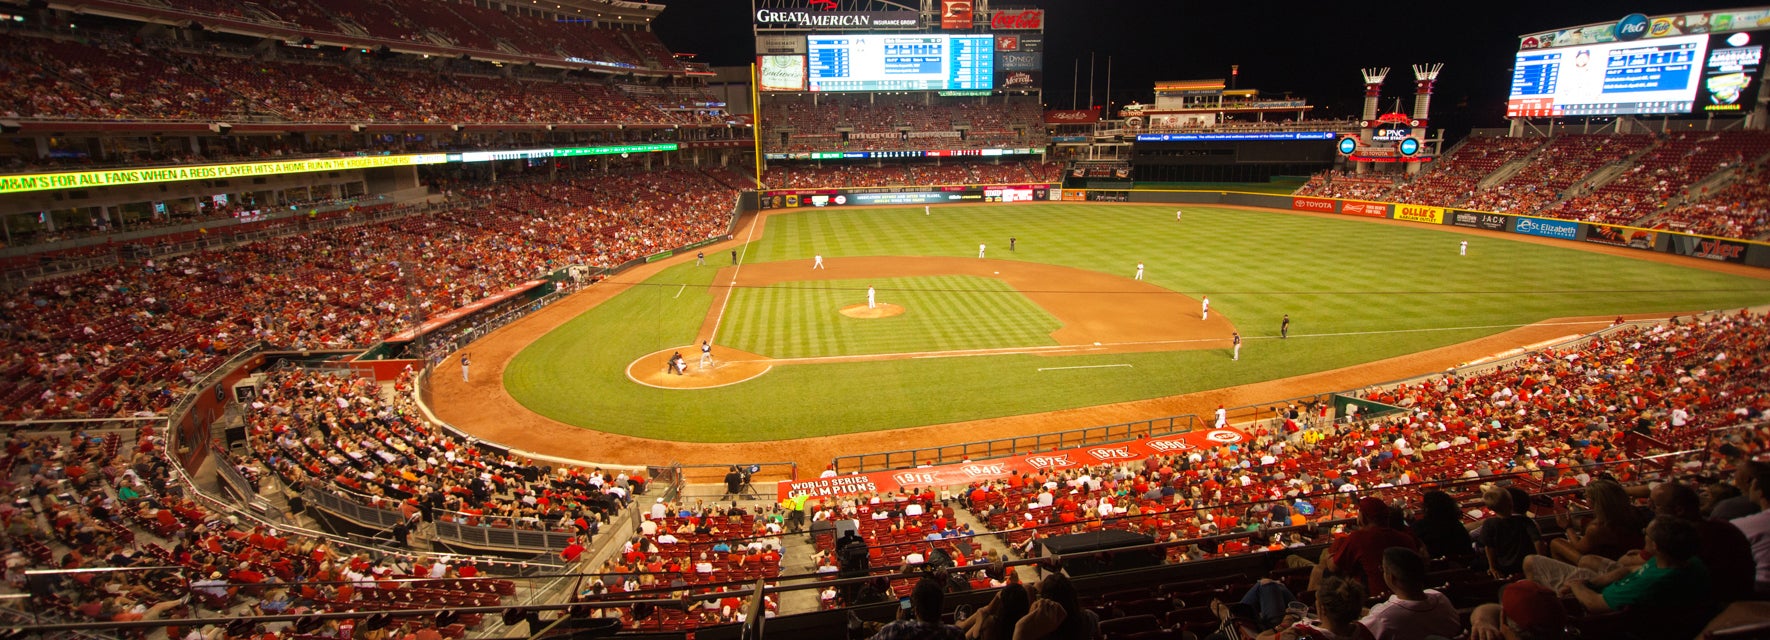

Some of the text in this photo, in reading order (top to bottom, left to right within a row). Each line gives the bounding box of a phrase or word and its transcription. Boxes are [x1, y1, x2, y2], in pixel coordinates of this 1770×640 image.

[757, 9, 870, 26] GREAT AMERICAN
[1620, 21, 1647, 34] P&G
[1651, 21, 1671, 34] Tide
[1386, 129, 1405, 137] PNC
[0, 176, 49, 190] M&M'S
[50, 175, 77, 187] FOR
[80, 173, 104, 185] ALL
[105, 171, 139, 183] FANS
[140, 170, 177, 181] WHEN
[180, 169, 188, 179] A
[190, 167, 216, 178] REDS
[218, 165, 252, 177] PLAYER
[254, 163, 275, 174] HITS
[276, 163, 282, 172] A
[283, 162, 305, 172] HOME
[308, 161, 323, 170] RUN
[324, 161, 331, 169] IN
[333, 160, 345, 168] THE
[348, 158, 372, 168] KROGER
[1305, 201, 1332, 209] TOYOTA
[1399, 214, 1419, 222] BARGAIN
[1401, 207, 1436, 219] OLLIE'S
[1481, 215, 1505, 224] JACK
[1531, 222, 1576, 234] St Elizabeth
[1540, 230, 1575, 238] HEALTHCARE
[1150, 439, 1186, 451] 1990
[1091, 449, 1129, 458] 1976
[1030, 455, 1067, 468] 1975
[963, 465, 1001, 477] 1940
[791, 475, 869, 490] WORLD SERIES
[896, 472, 933, 484] 1919
[788, 482, 877, 499] CHAMPIONS
